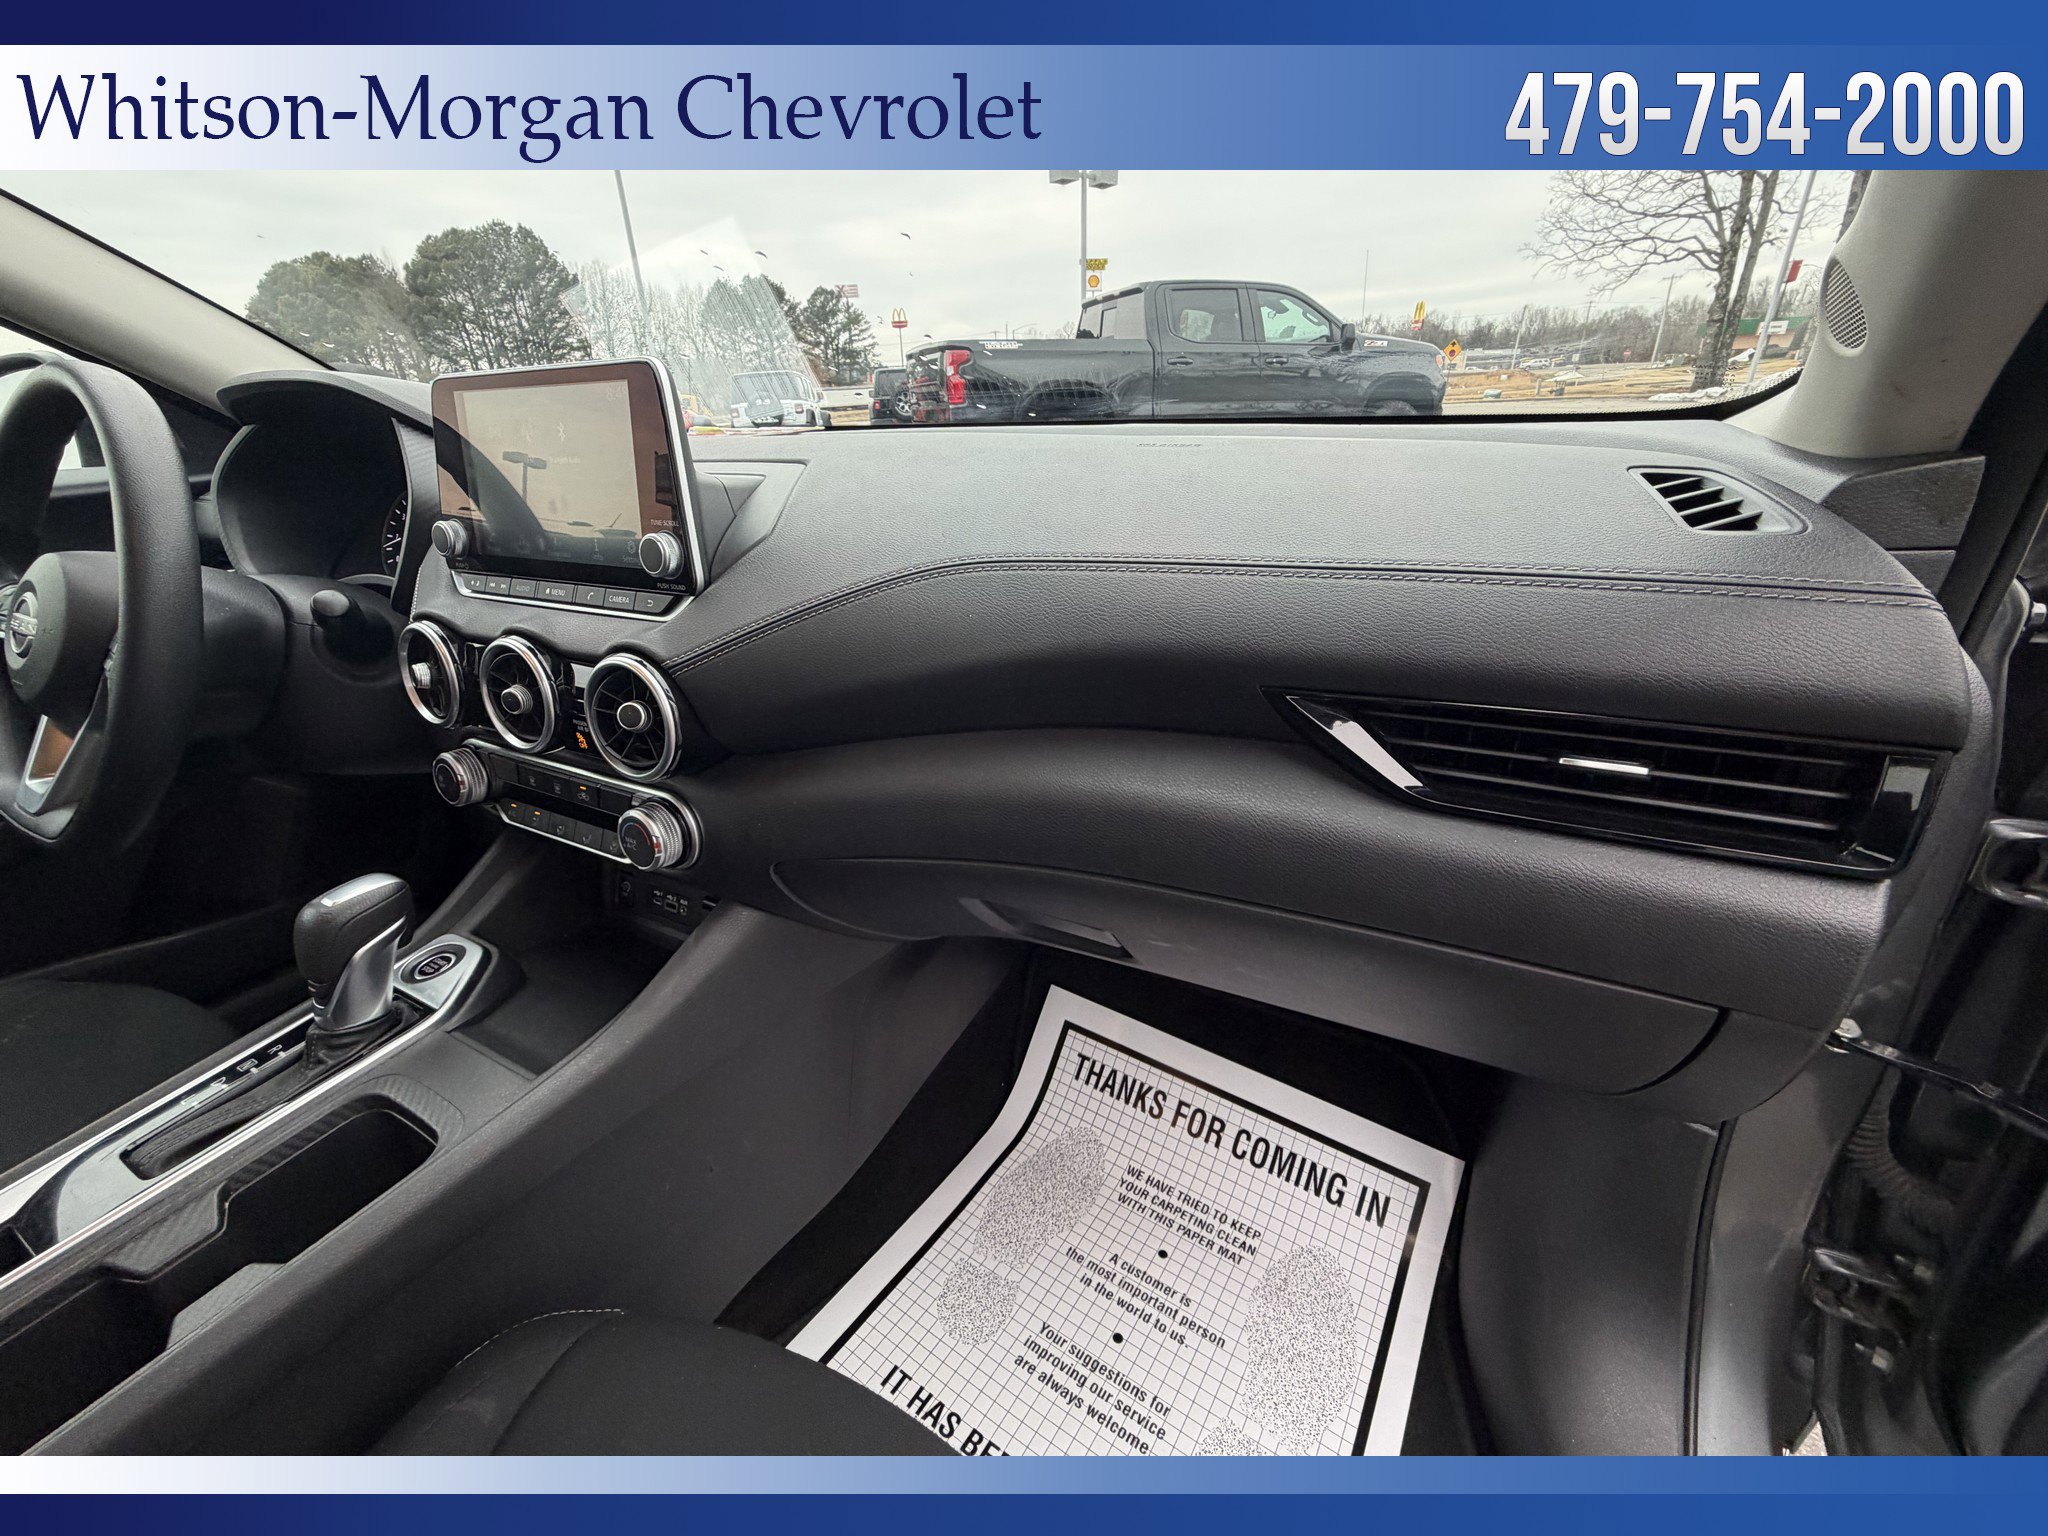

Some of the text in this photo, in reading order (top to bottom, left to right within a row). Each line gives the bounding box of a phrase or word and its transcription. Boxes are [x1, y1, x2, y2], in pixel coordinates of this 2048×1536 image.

[551, 588, 566, 596] MENU
[608, 595, 631, 604] CAMERA
[670, 583, 687, 591] SOUND
[267, 1044, 283, 1055] R
[1073, 1052, 1391, 1229] THANKS FOR COMING IN
[1117, 1192, 1246, 1266] WITH THIS PAPER MAT
[1119, 1177, 1257, 1256] YOUR CARPETING CLEAN
[1126, 1165, 1262, 1240] WE HAVE TRIED TO KEEP
[1065, 1246, 1226, 1348] the most important person
[1080, 1273, 1093, 1288] in
[1094, 1282, 1114, 1300] the
[1116, 1296, 1153, 1324] world
[1153, 1318, 1167, 1333] to
[1108, 1253, 1192, 1308] A customer is
[1014, 1355, 1149, 1455] are always welcome
[1023, 1335, 1166, 1440] improving our service
[1038, 1321, 1172, 1417] Your suggestions for
[880, 1364, 1011, 1456] IT HAS BE
